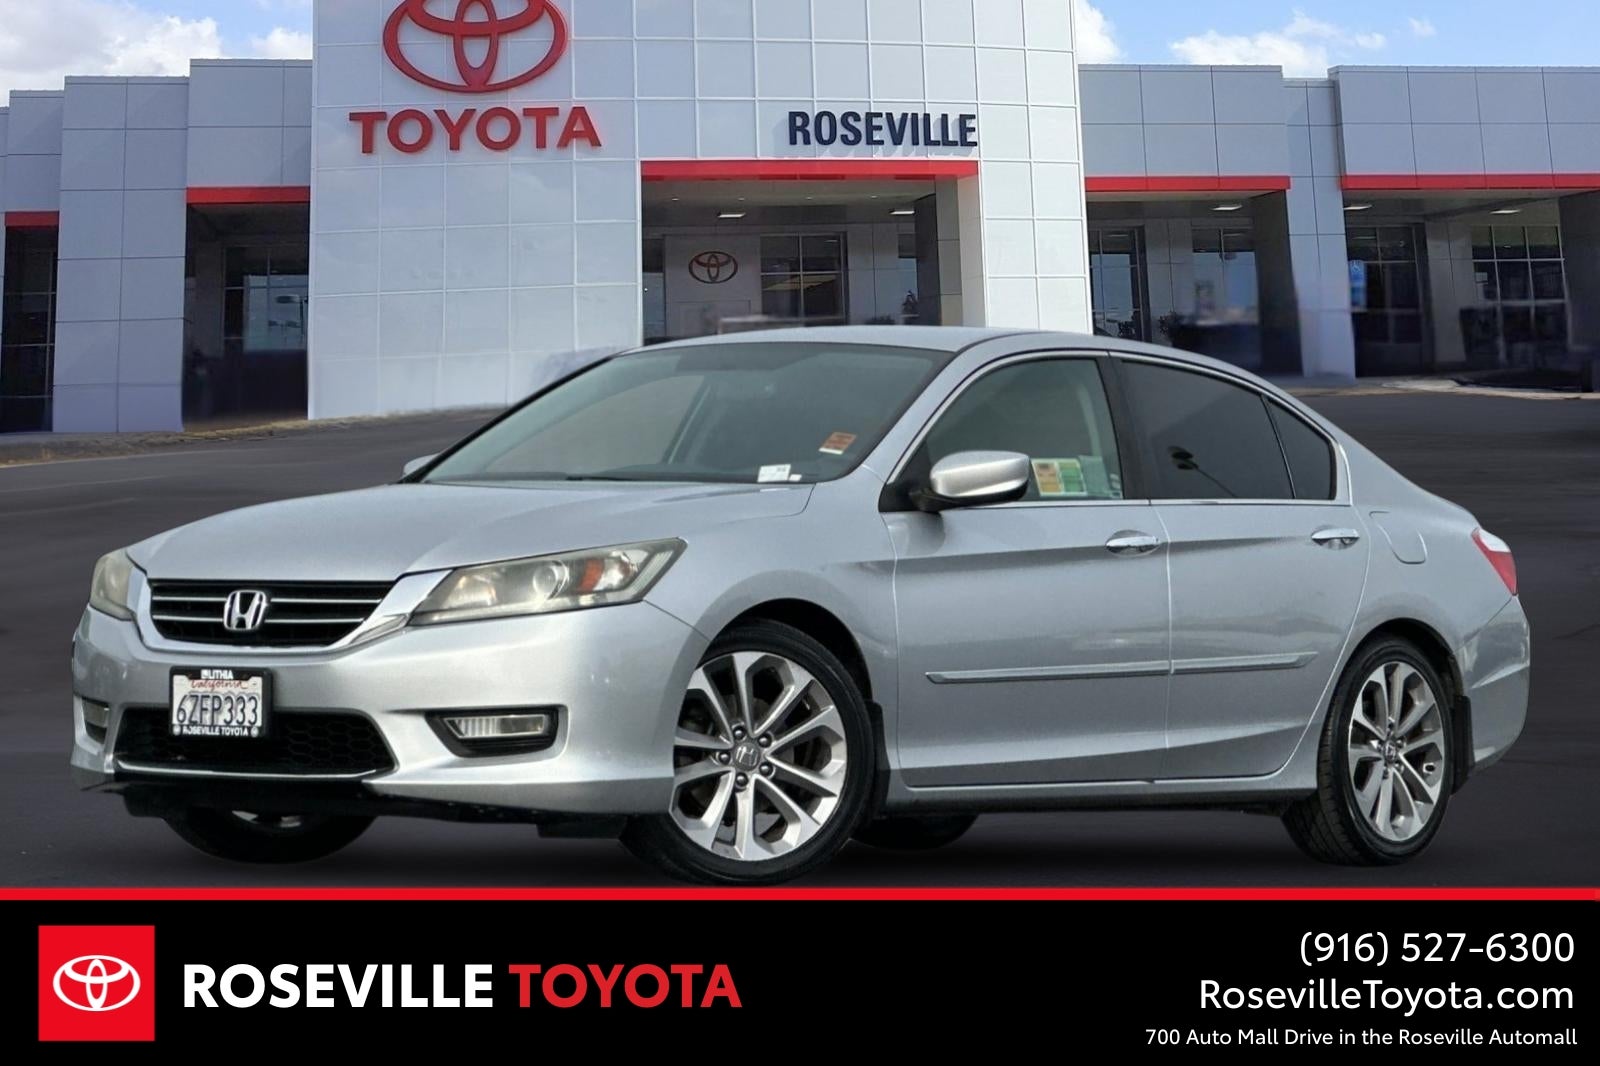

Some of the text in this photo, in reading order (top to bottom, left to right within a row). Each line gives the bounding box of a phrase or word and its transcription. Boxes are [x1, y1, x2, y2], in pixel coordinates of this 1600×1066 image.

[349, 107, 602, 154] TOYOTA
[789, 111, 978, 148] ROSEVILLE
[209, 669, 234, 680] LITHIA
[176, 694, 259, 726] 6ZFP333
[182, 726, 249, 737] ROSEVILLE TOYOTA
